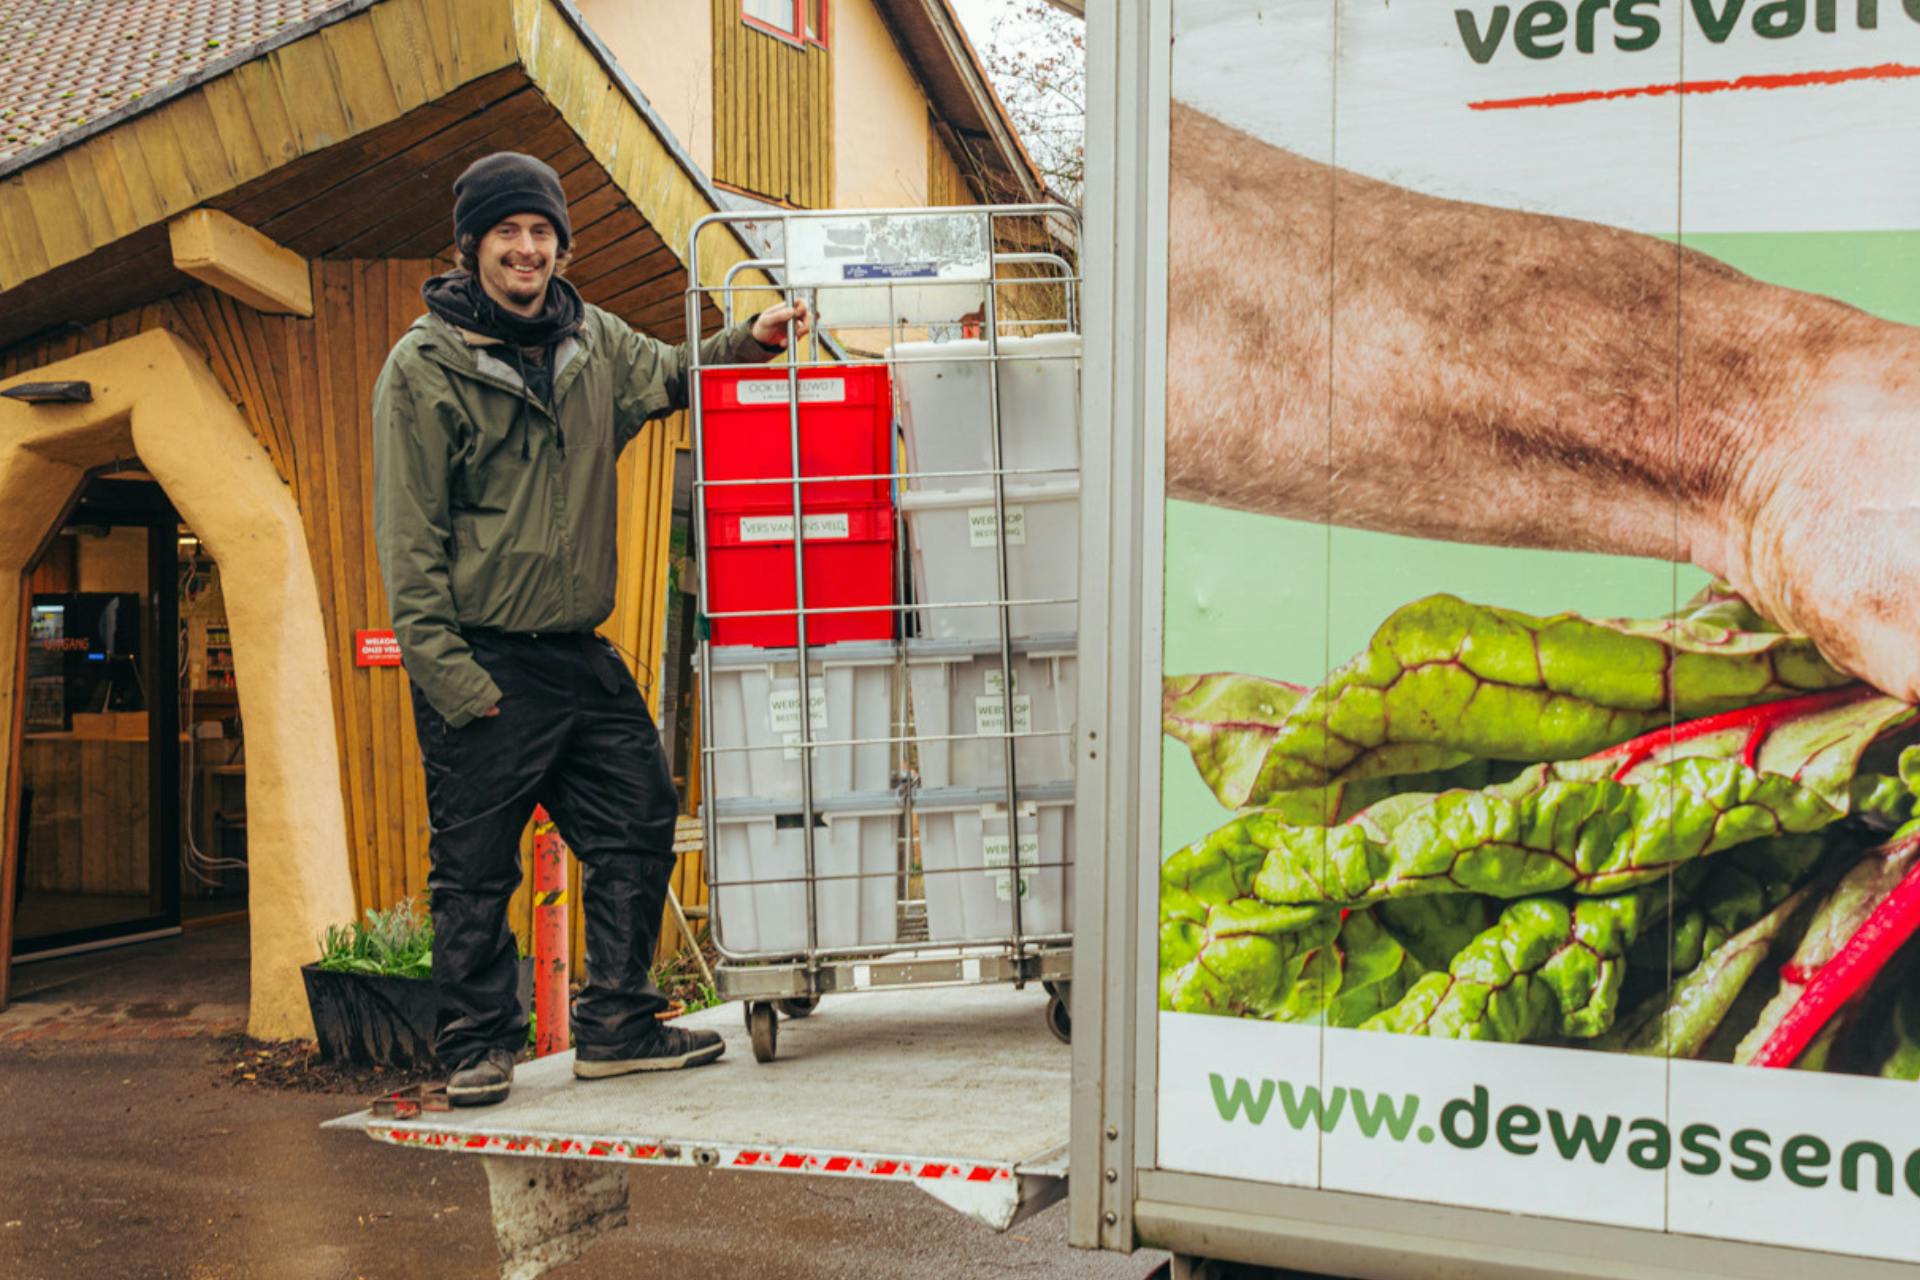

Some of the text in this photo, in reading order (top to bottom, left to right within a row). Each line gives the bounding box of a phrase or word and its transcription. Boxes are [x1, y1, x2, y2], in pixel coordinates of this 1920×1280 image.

[1455, 0, 1661, 64] vers
[970, 513, 1022, 526] WEBSOP
[771, 696, 825, 710] WEBSOP
[978, 704, 1029, 715] WEBSOP
[984, 843, 1037, 854] WEBOP
